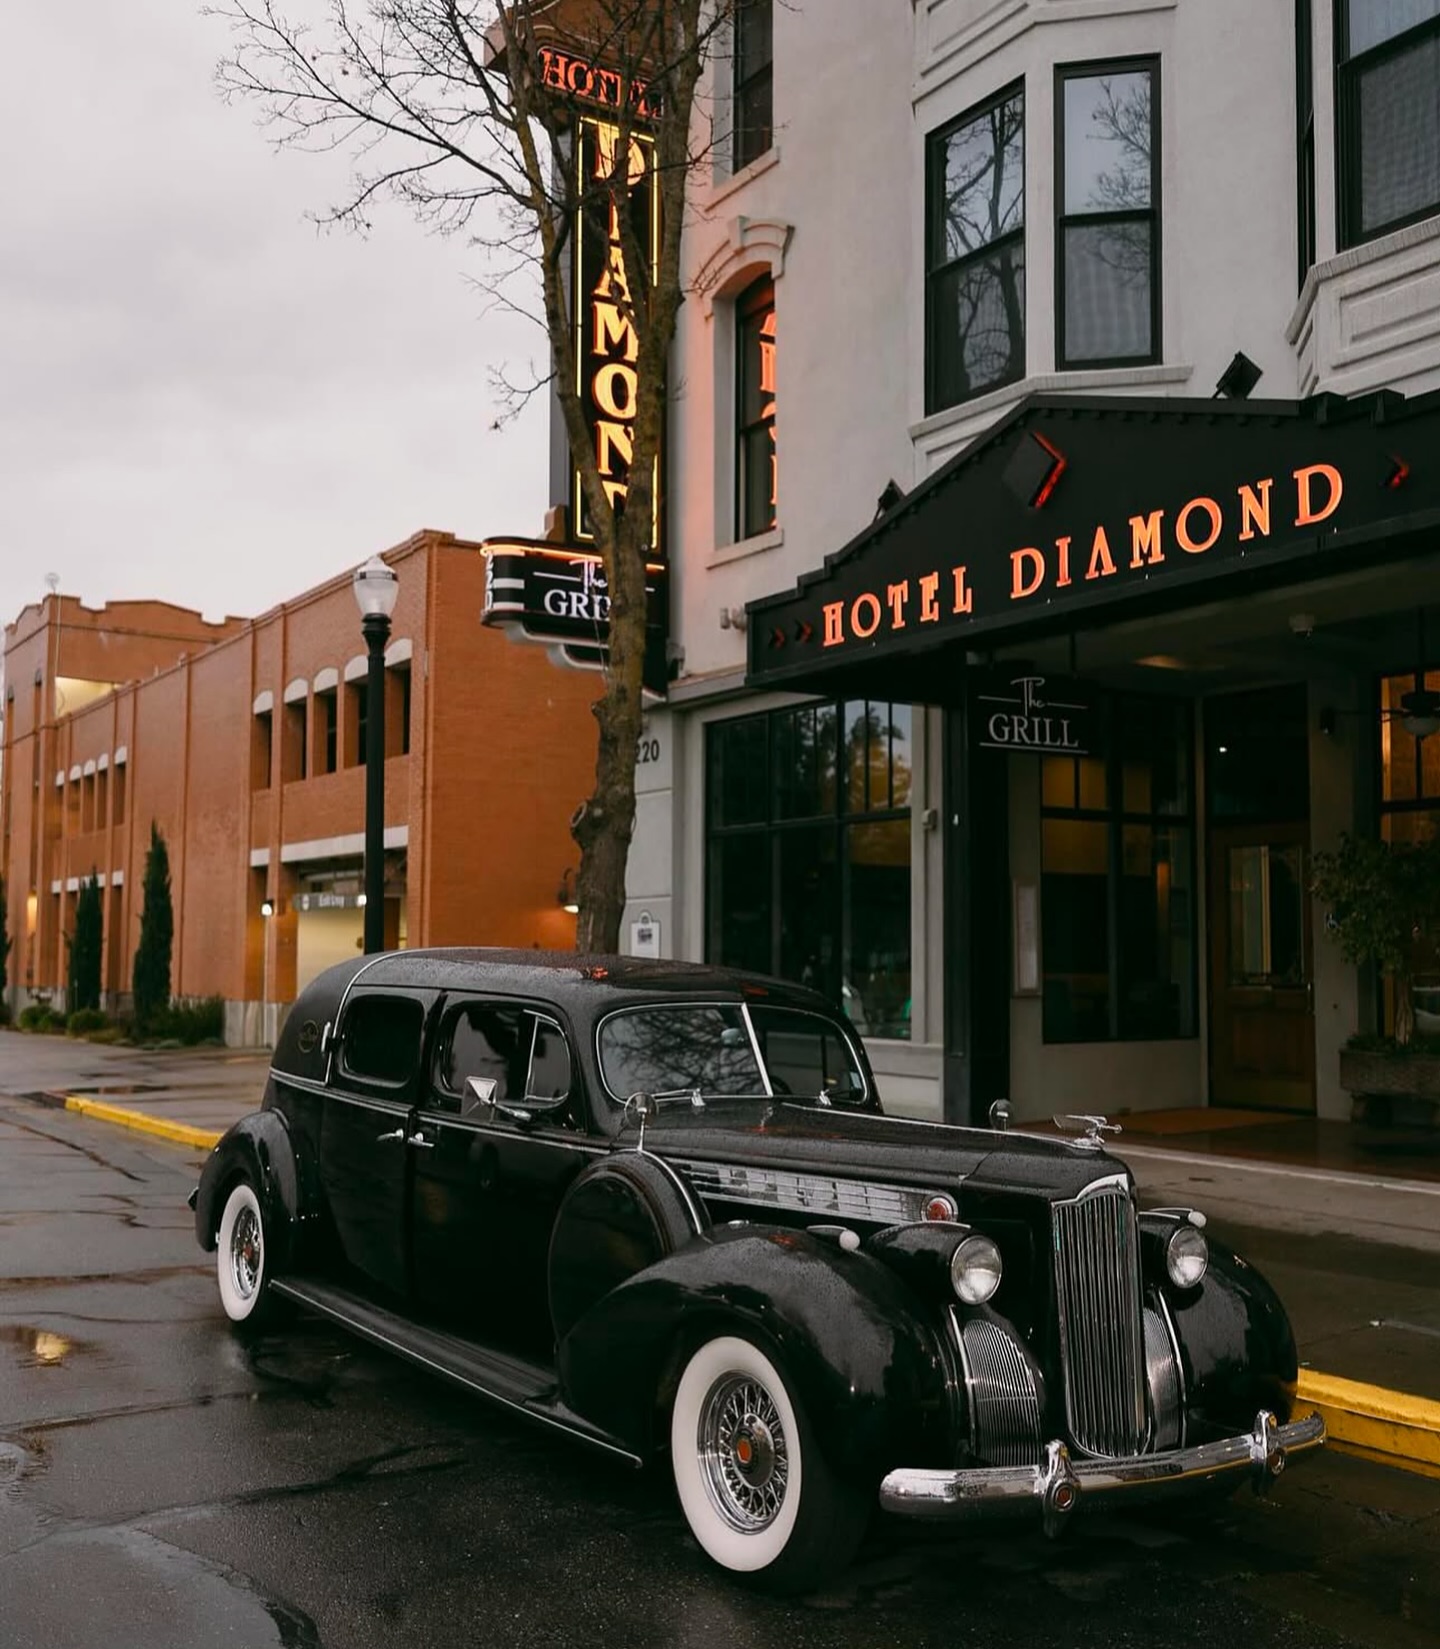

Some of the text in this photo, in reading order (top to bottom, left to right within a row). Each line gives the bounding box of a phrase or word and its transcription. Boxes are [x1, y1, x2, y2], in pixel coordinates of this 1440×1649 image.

[592, 121, 646, 512] DAMON
[821, 463, 1344, 648] HOTEL DIAMOND
[569, 558, 608, 595] The
[543, 589, 612, 622] GRI
[1010, 676, 1046, 717] The
[988, 712, 1080, 748] GRILL
[634, 738, 660, 764] 220
